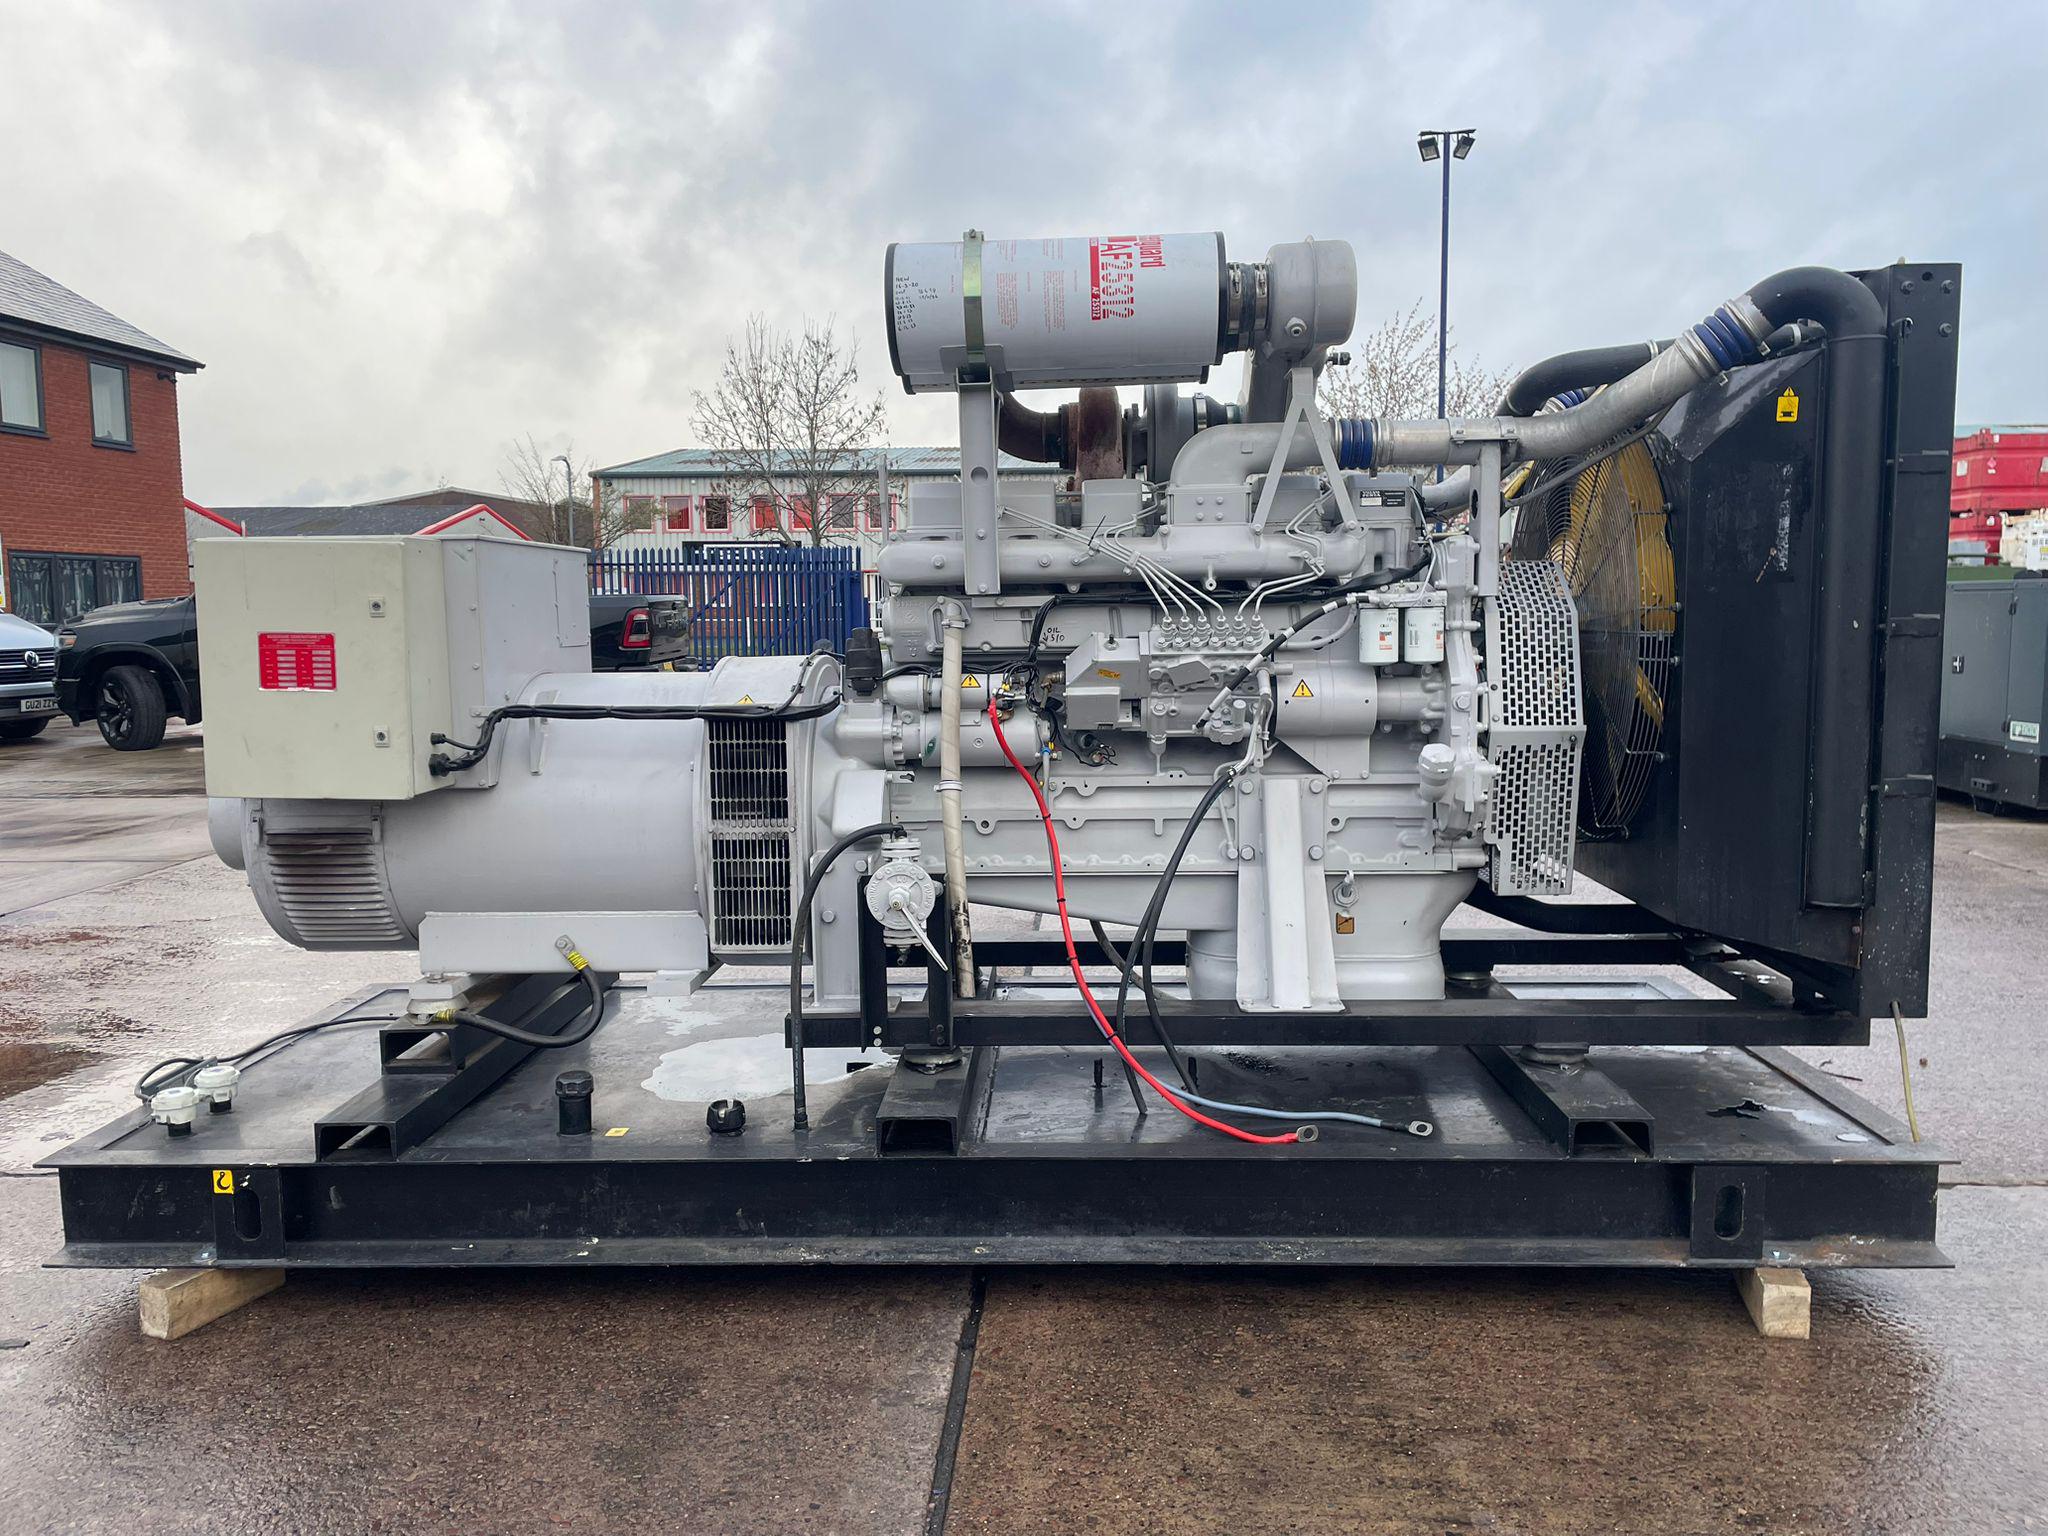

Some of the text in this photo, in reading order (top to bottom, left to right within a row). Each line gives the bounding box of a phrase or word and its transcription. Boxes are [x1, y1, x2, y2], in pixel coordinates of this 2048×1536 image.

[1092, 286, 1101, 318] AF 25312
[1100, 243, 1134, 319] AF25312
